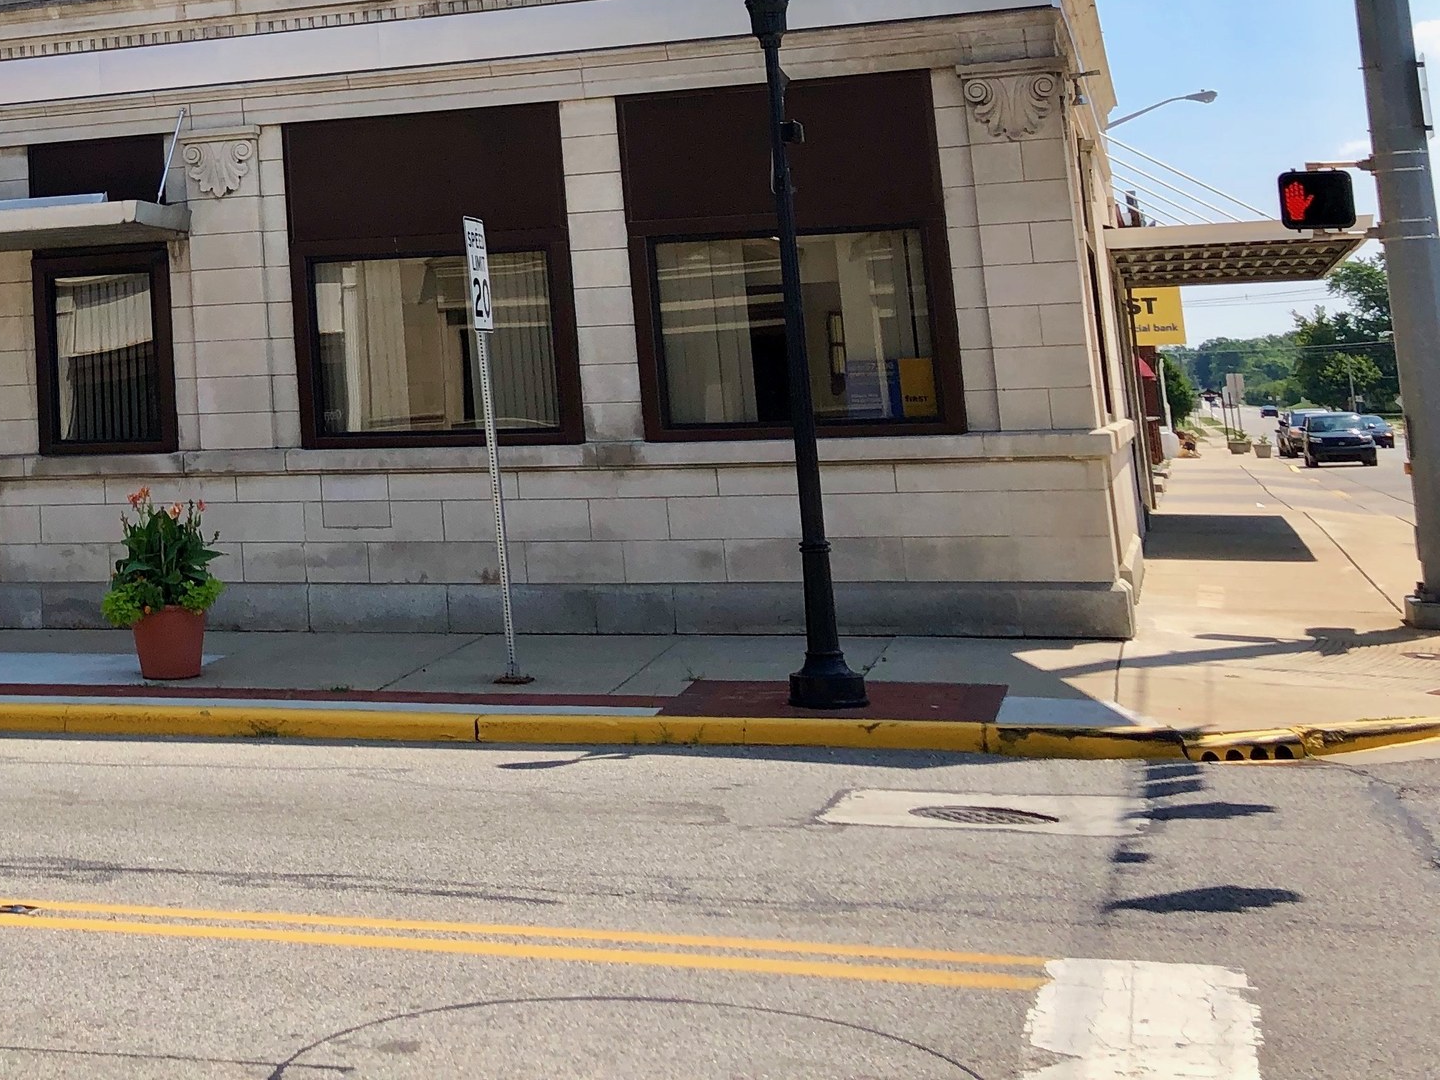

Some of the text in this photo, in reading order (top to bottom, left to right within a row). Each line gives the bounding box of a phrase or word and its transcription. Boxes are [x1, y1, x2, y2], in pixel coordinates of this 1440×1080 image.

[468, 231, 484, 249] SPEED
[473, 277, 490, 318] 20
[1153, 323, 1178, 332] bank
